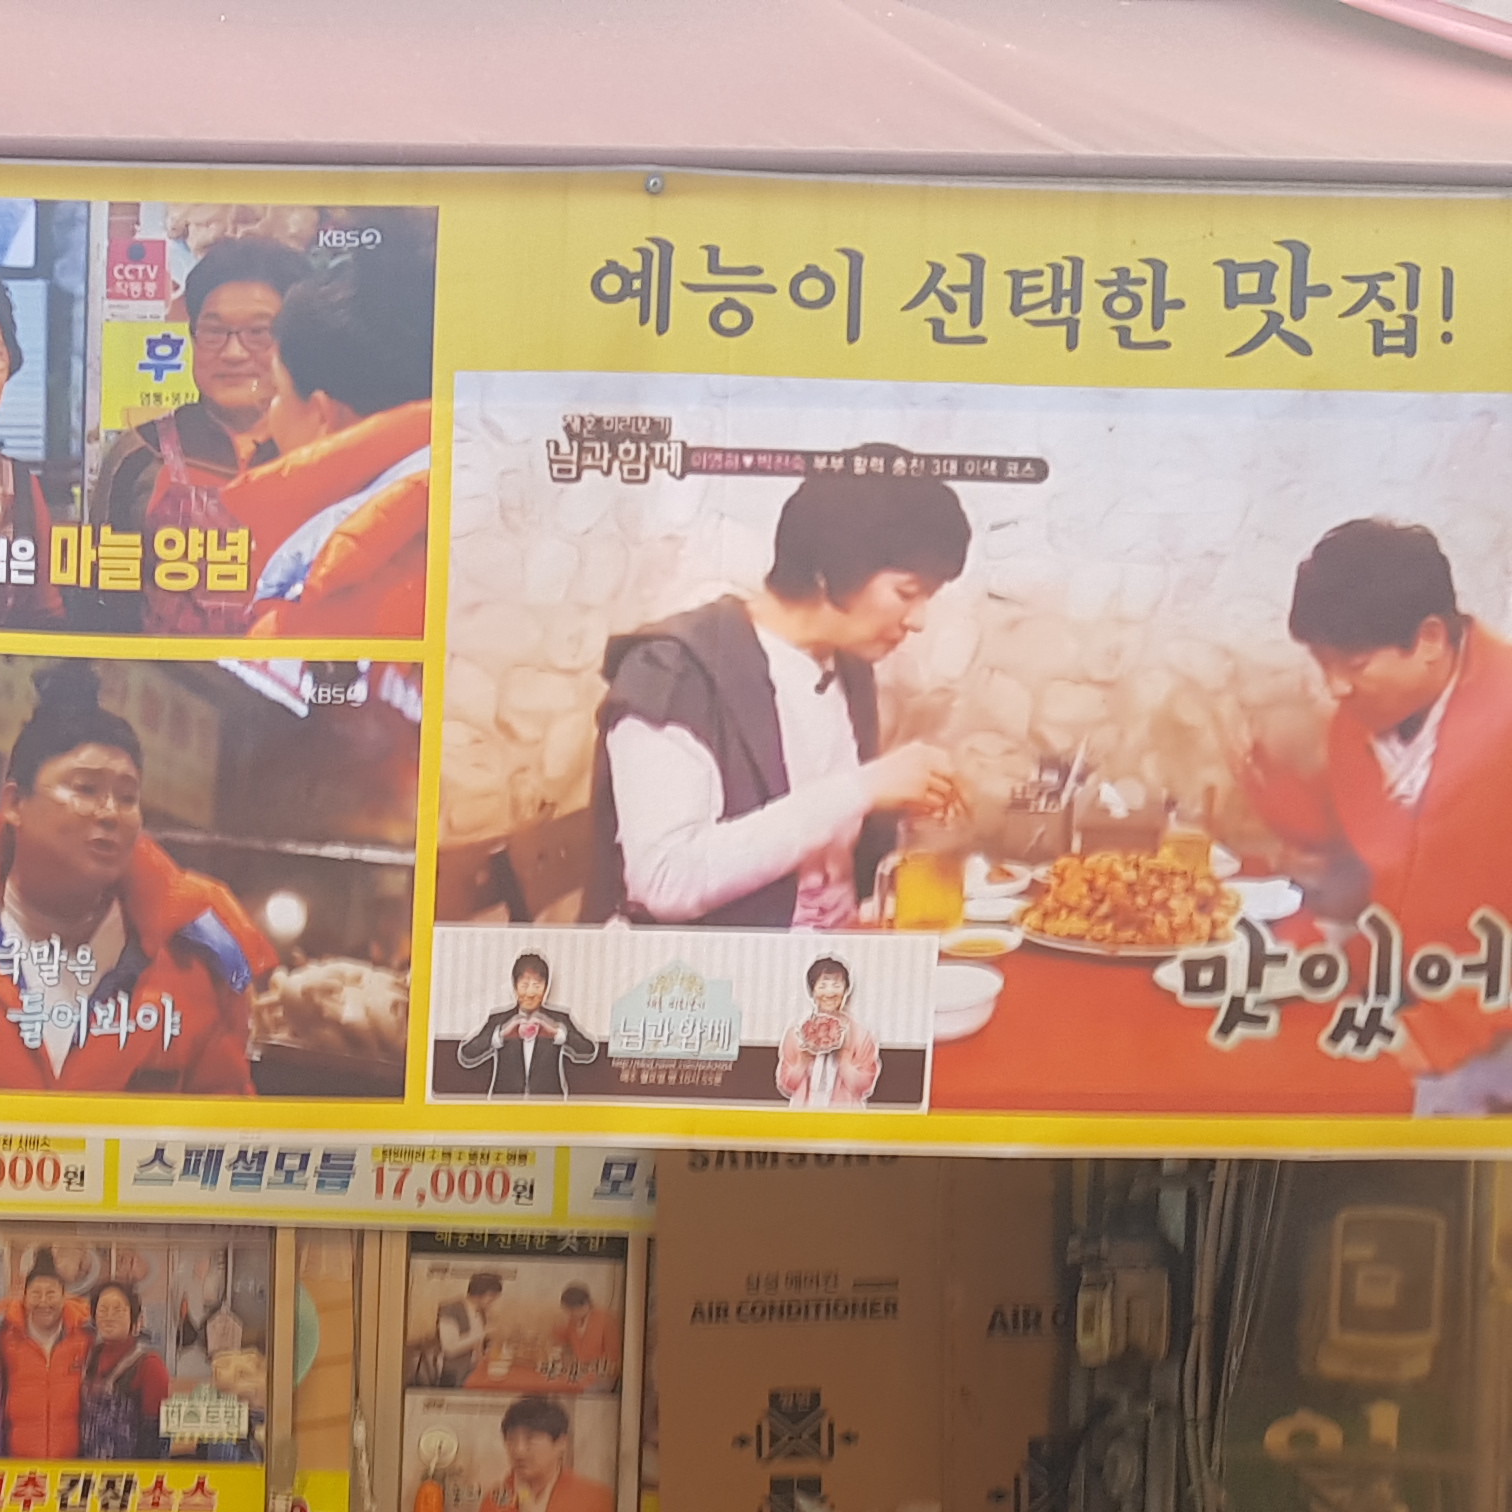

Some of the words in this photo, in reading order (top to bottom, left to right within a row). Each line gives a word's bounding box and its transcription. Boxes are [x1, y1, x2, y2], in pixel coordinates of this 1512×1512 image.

[113, 264, 159, 280] CCTV
[589, 236, 865, 343] 예능이
[900, 252, 1185, 351] 선택한
[1212, 239, 1456, 359] 맛집!
[138, 333, 185, 382] 후
[548, 440, 611, 480] 님과
[618, 440, 684, 482] 함께
[814, 454, 845, 472] 부부
[1005, 461, 1036, 478] 코스
[49, 524, 143, 589] 마늘
[152, 526, 252, 592] 양념
[1181, 911, 1506, 1052] 맛있어
[132, 1141, 360, 1196] 스페셜모듬
[372, 1163, 535, 1208] 17,000원
[690, 1300, 729, 1325] AIR
[736, 1297, 899, 1324] CONDITIONER
